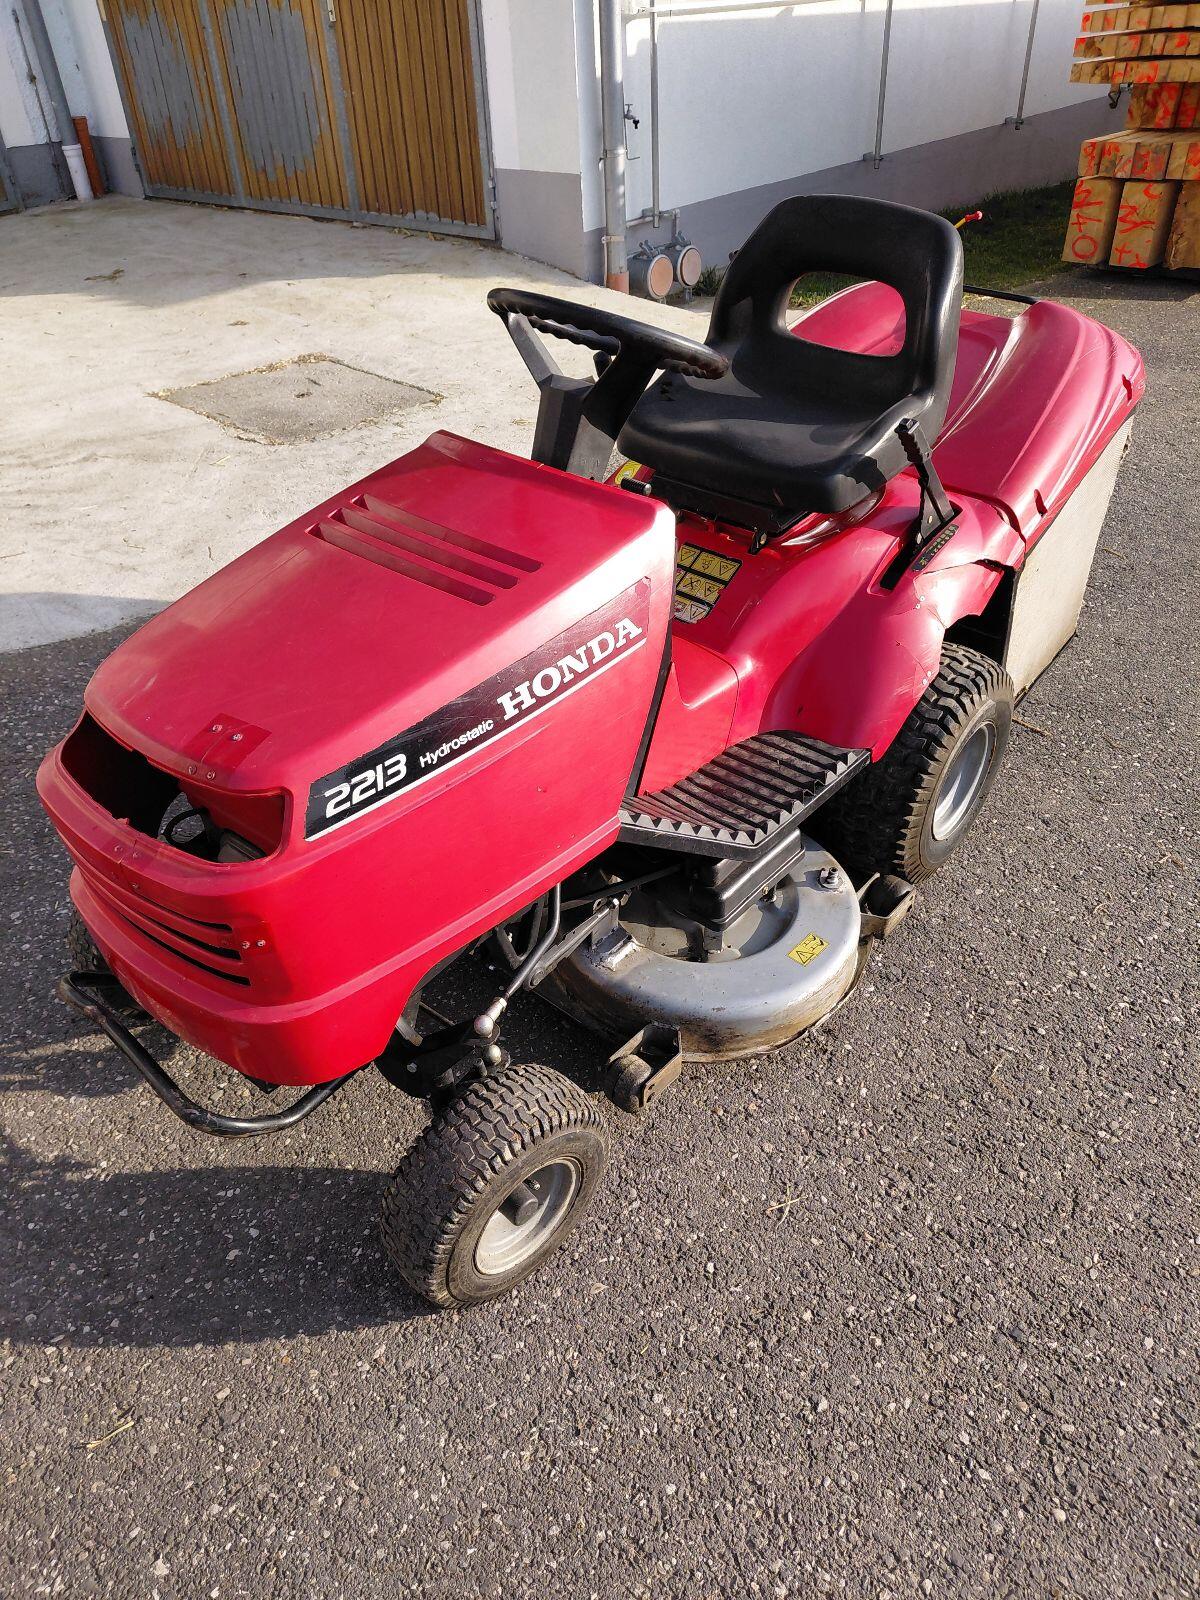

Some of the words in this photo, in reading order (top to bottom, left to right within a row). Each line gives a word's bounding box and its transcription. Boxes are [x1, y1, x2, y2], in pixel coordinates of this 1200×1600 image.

[324, 753, 408, 819] 2213
[419, 718, 494, 768] Hydrostatic
[496, 617, 643, 721] HONDA
